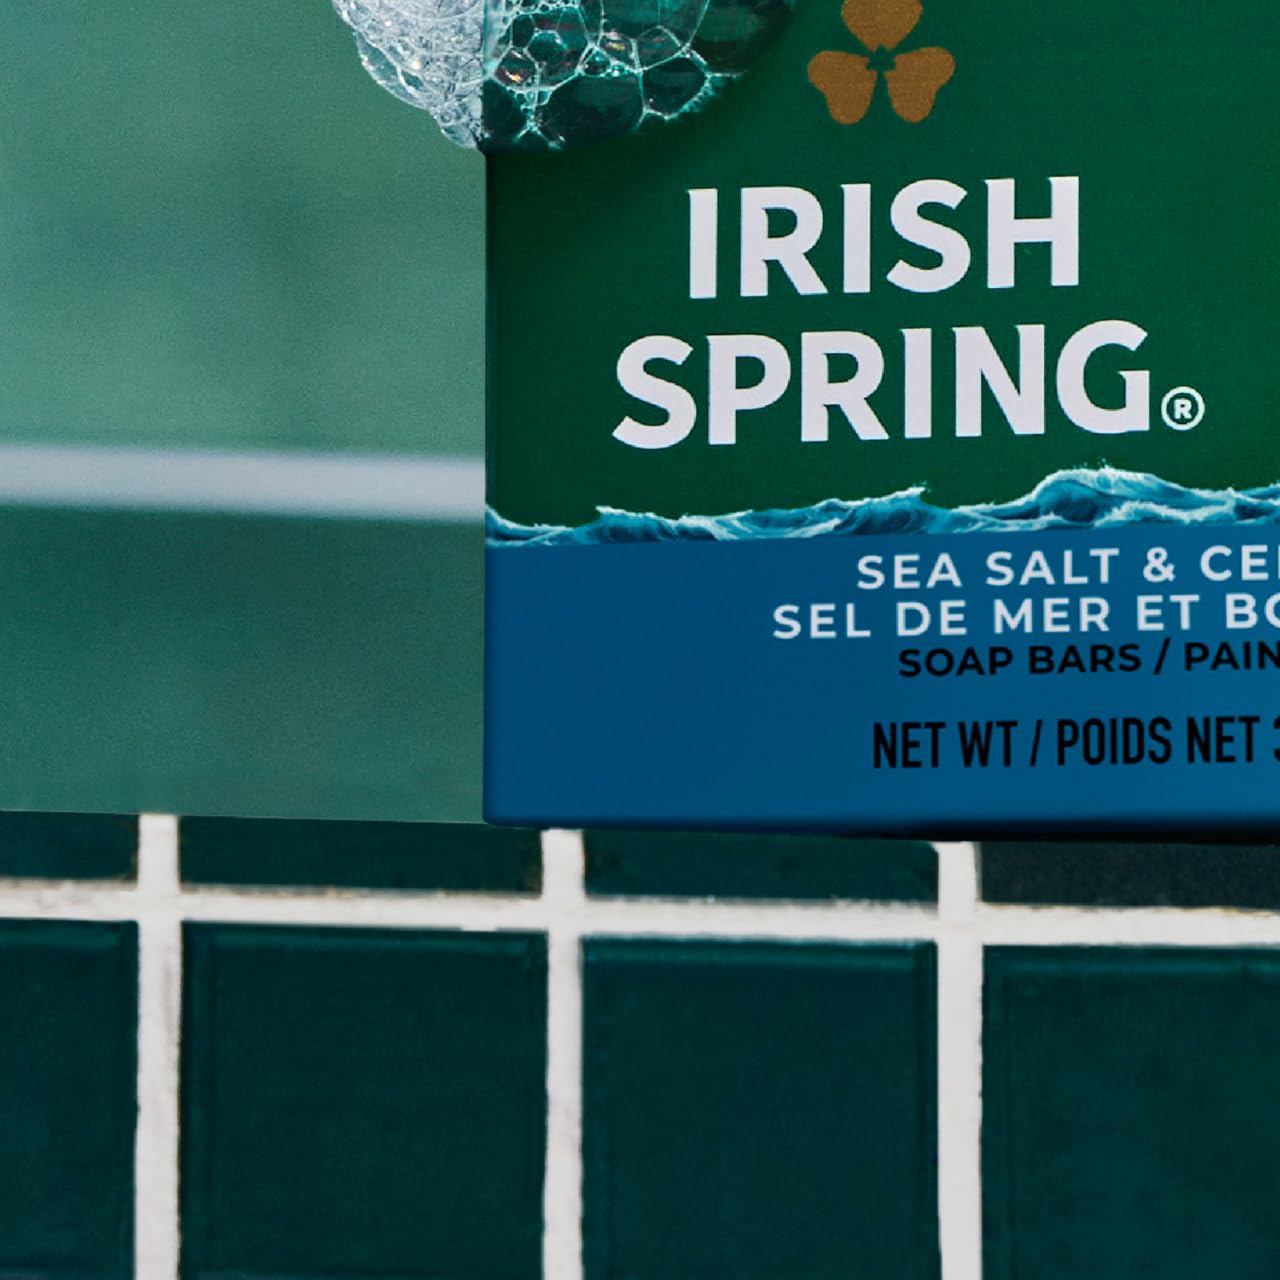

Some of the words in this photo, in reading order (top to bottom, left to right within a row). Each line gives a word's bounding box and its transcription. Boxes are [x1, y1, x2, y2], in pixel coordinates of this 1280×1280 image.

[688, 175, 1080, 299] IRISH
[857, 552, 962, 590] SEA
[986, 548, 1120, 586] SALT
[1143, 546, 1175, 583] &
[773, 603, 871, 639] SEL
[897, 599, 967, 637] DE
[994, 597, 1110, 634] MER
[1137, 594, 1200, 631] ET
[898, 646, 1014, 678] SOAP
[1028, 643, 1142, 675] BARS
[873, 721, 947, 769] NET
[957, 720, 1019, 768] WT
[1057, 716, 1172, 766] POIDS
[1186, 715, 1261, 764] NET
